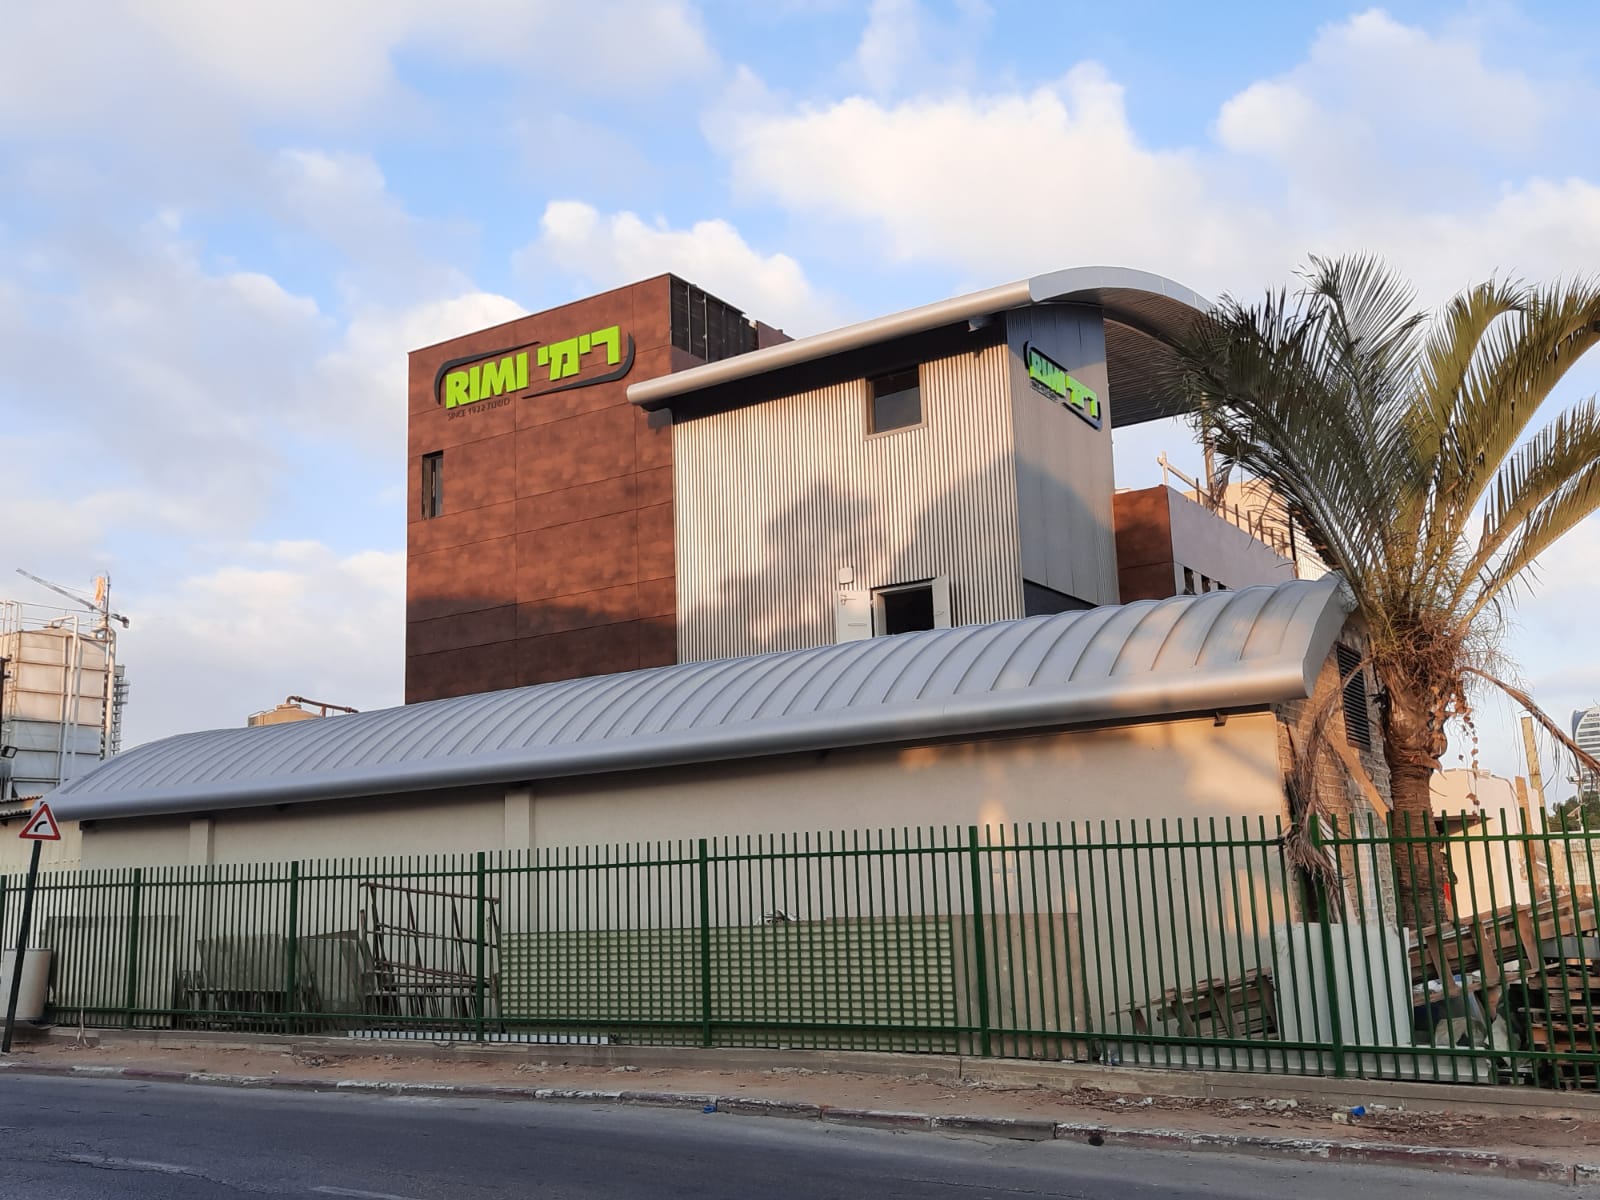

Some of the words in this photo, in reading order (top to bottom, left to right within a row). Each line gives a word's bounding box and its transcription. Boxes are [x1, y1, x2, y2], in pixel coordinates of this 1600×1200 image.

[446, 353, 528, 408] RIMI
[537, 325, 620, 381] רימי
[1029, 351, 1065, 398] RIMI
[1065, 375, 1098, 418] רימי
